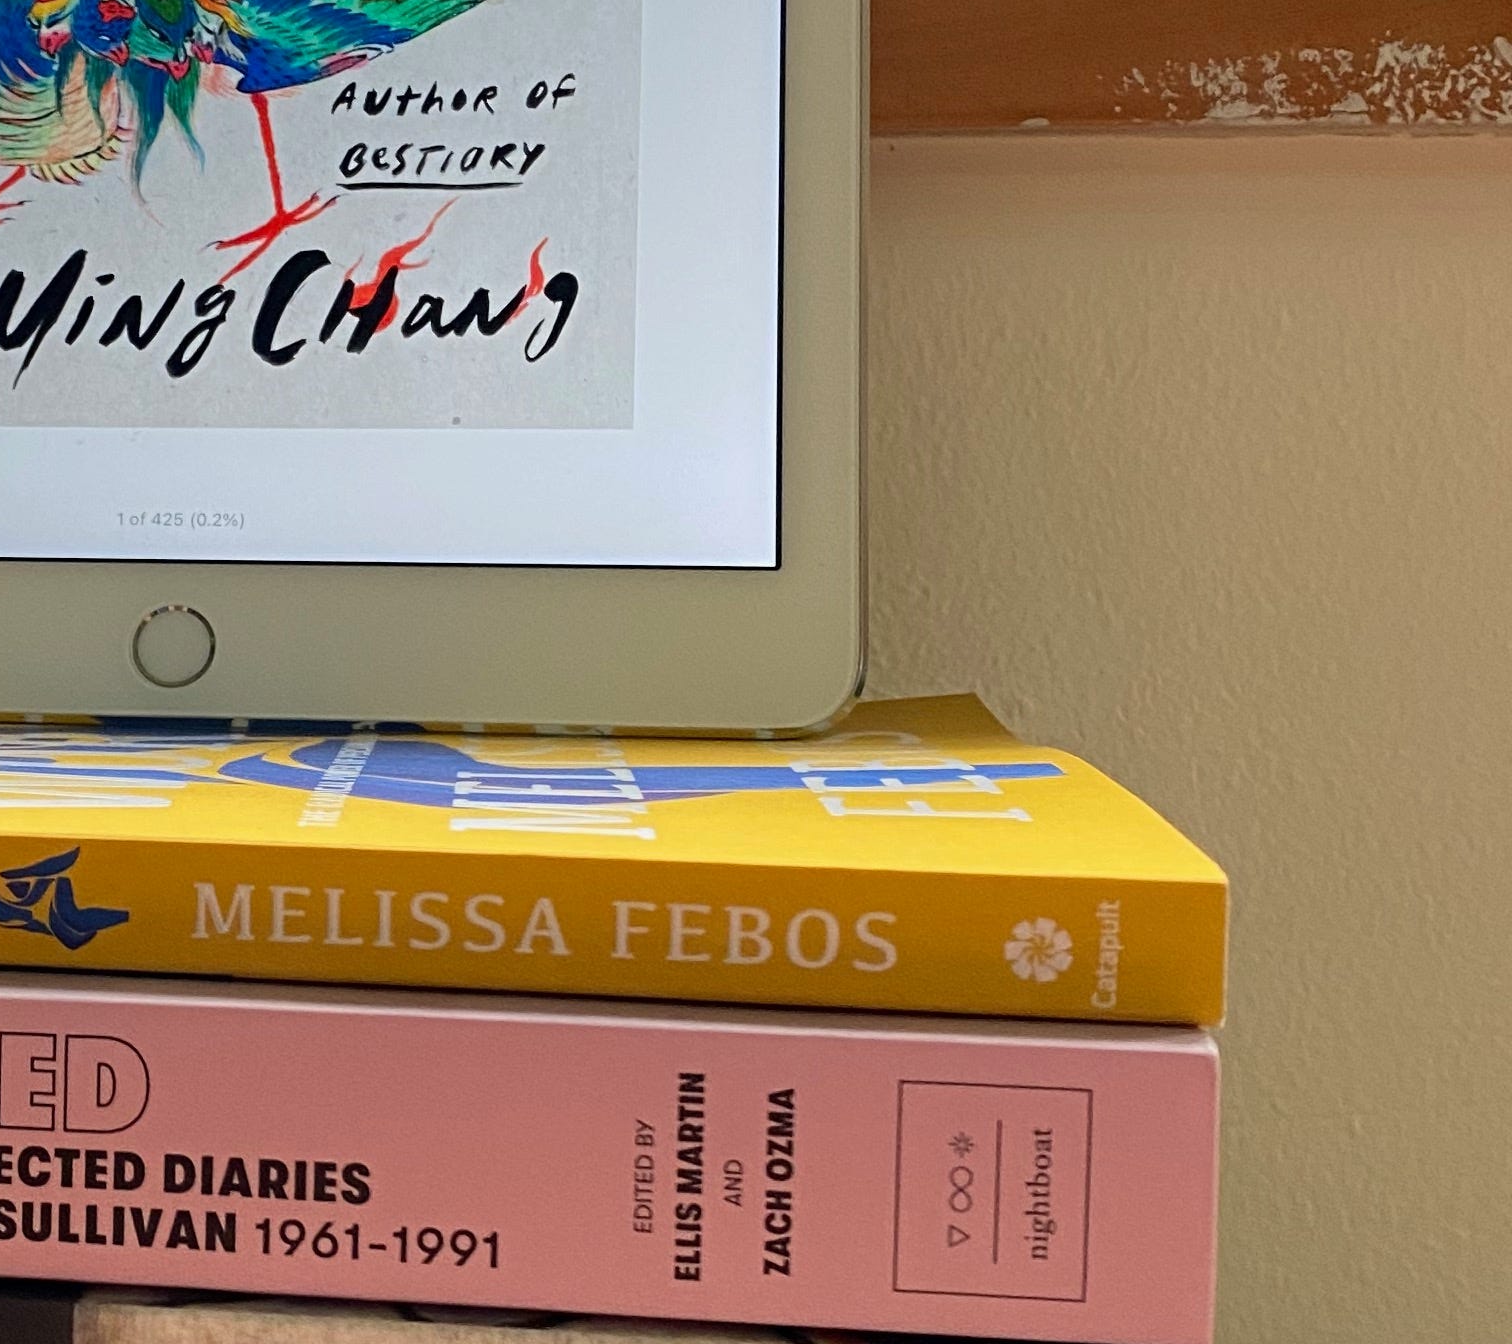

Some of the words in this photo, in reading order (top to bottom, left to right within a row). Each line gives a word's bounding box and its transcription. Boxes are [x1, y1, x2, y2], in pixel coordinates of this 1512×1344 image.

[117, 513, 124, 526] 1
[129, 512, 147, 526] of
[151, 513, 184, 526] 425
[190, 513, 245, 530] (0.2%)
[190, 881, 571, 957] MELISSA
[612, 901, 899, 974] FEBOS
[1090, 899, 1125, 1009] Catapult
[635, 1119, 657, 1147] BY
[676, 1072, 706, 1197] MARTIN
[766, 1088, 795, 1182] OZMA
[163, 1153, 372, 1204] DIARIES
[633, 1152, 656, 1234] EDITED
[723, 1158, 744, 1207] AND
[1025, 1127, 1058, 1261] nightboat
[674, 1203, 704, 1282] ELLIS
[763, 1189, 793, 1276] ZACH
